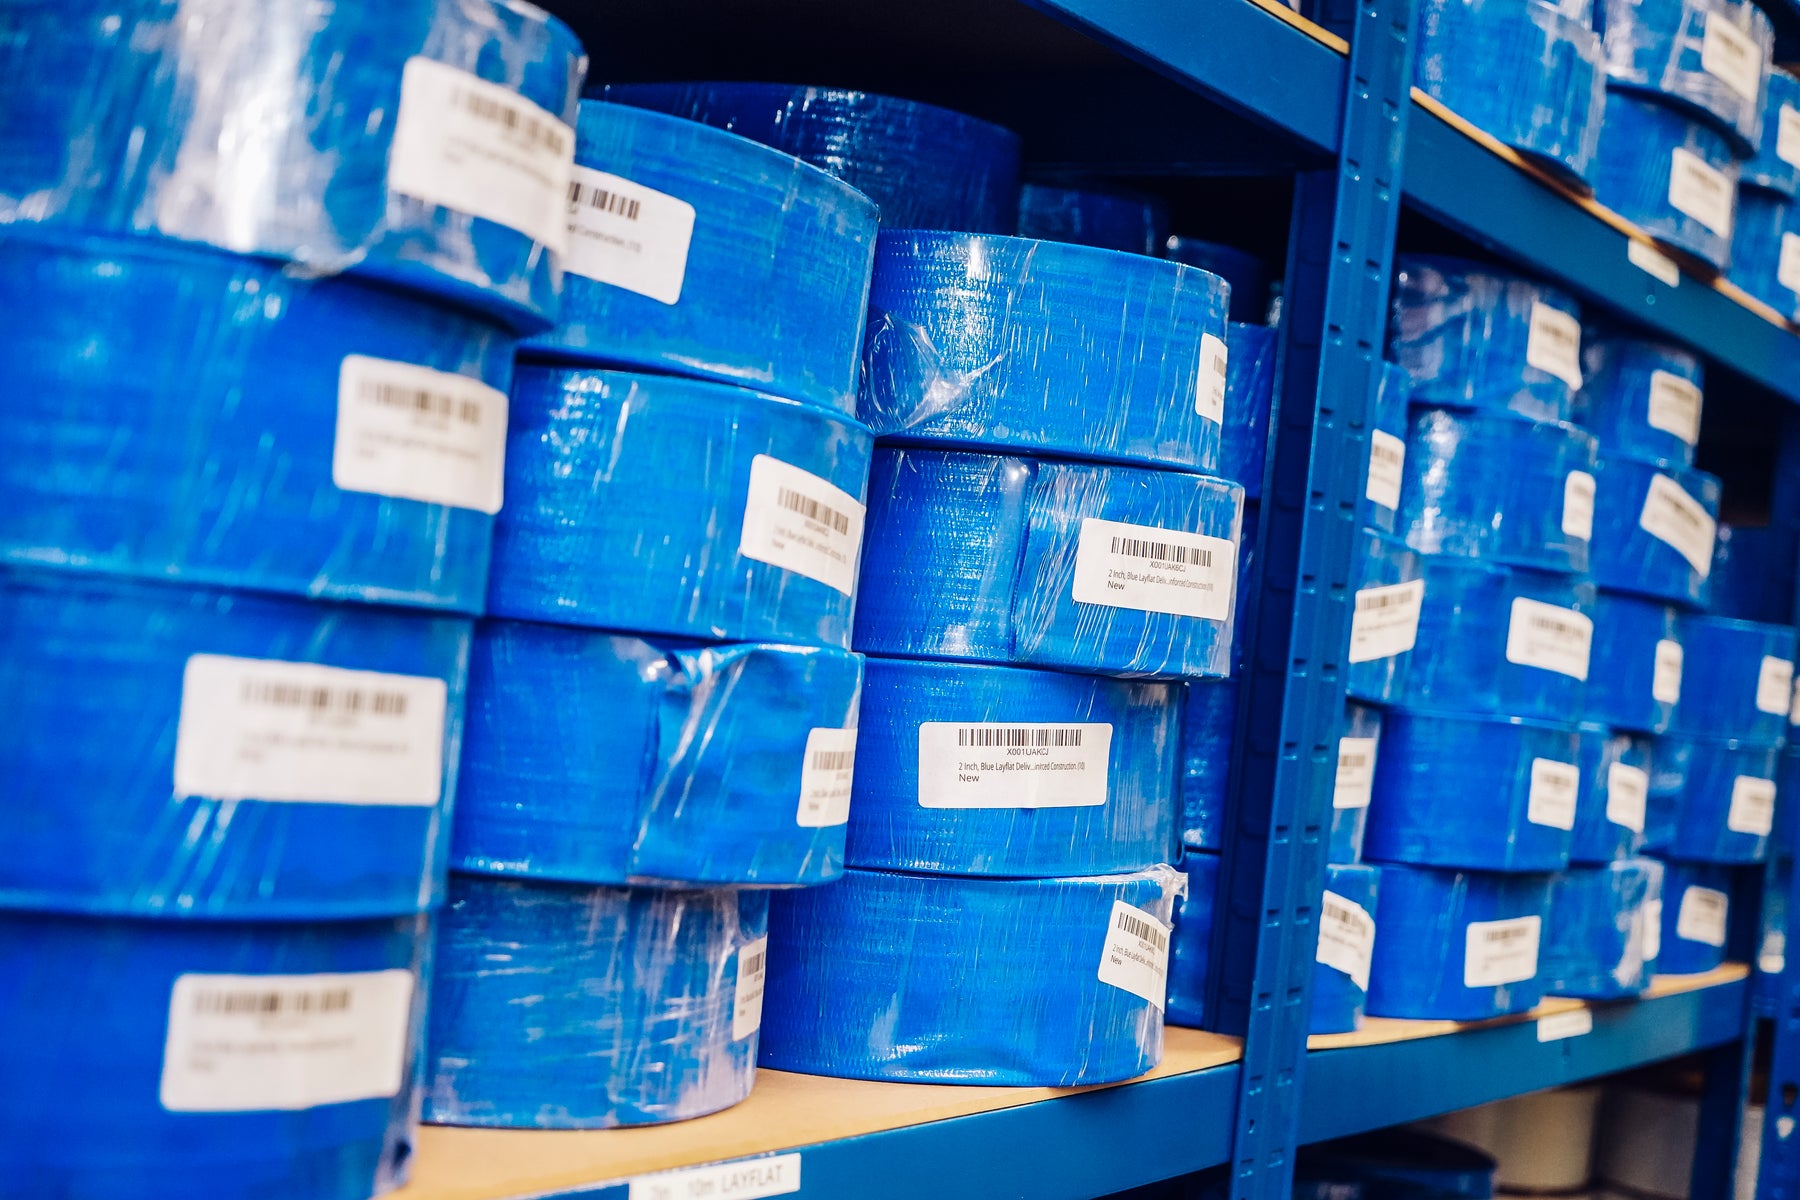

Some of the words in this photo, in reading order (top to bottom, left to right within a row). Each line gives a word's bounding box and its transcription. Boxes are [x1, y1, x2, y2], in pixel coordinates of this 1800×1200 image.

[1108, 569, 1113, 577] 2
[1127, 571, 1138, 581] Blue
[1138, 573, 1156, 584] Layflat
[1107, 580, 1125, 590] New
[958, 762, 963, 770] 2
[964, 762, 979, 771] Inch,
[980, 762, 994, 771] Blue
[995, 762, 1015, 772] Layflat
[958, 774, 980, 782] New
[1110, 955, 1122, 966] New
[721, 1164, 783, 1193] LAYFLAT
